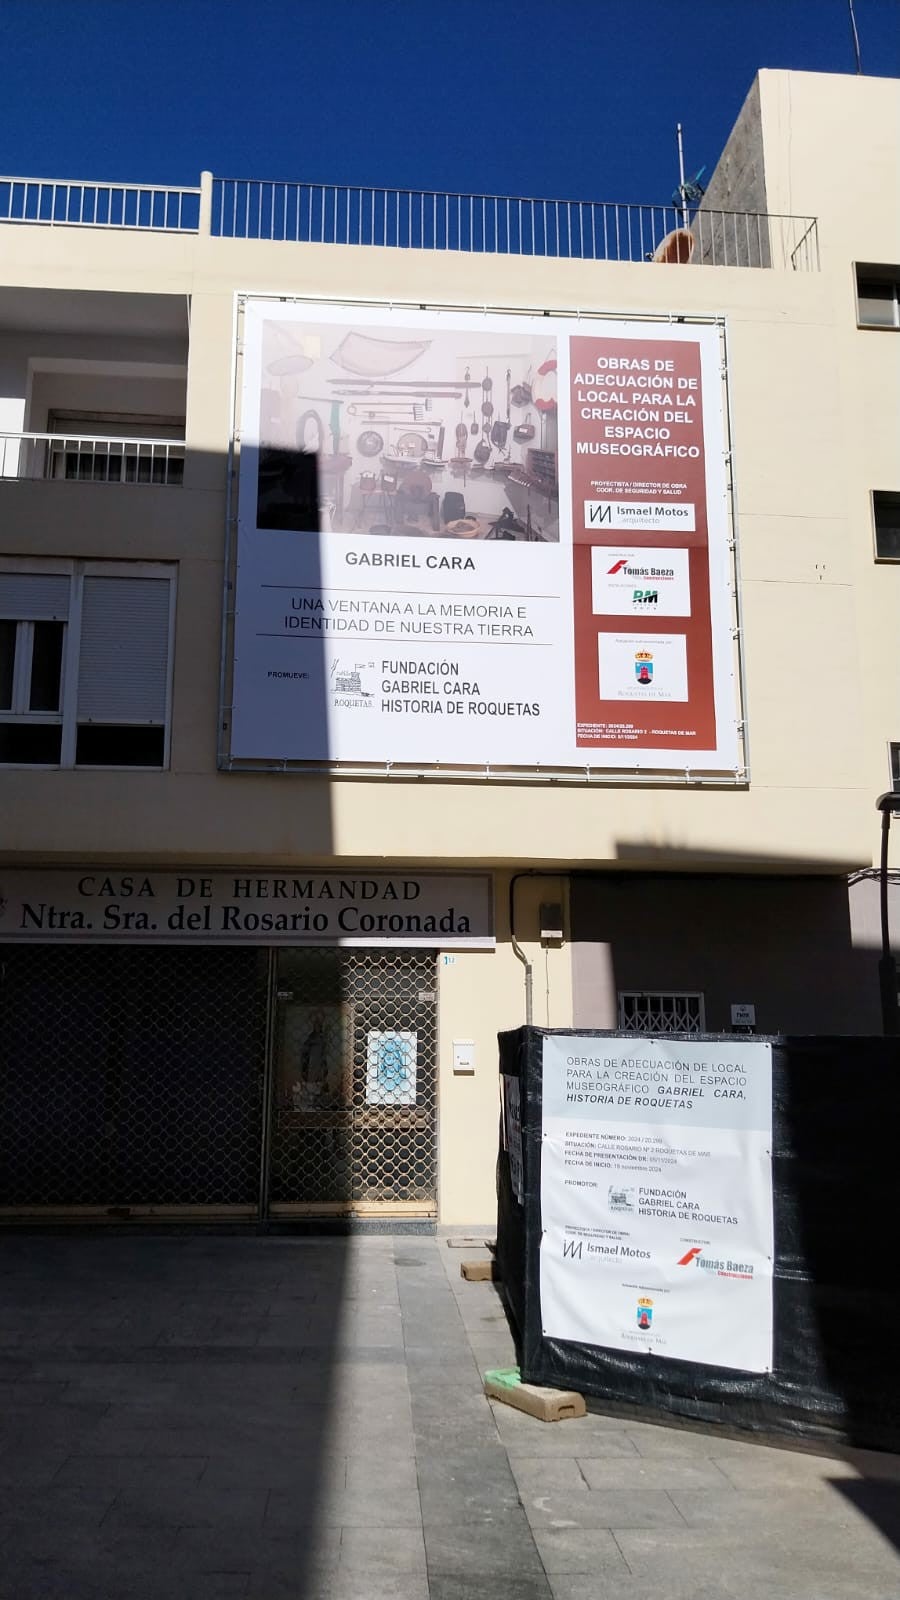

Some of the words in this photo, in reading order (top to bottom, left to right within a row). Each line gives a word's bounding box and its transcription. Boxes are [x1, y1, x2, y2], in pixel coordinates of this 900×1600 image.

[597, 357, 650, 371] OBRAS
[655, 360, 674, 372] DE
[574, 373, 673, 389] ADECUACIÓN
[678, 378, 698, 390] DE
[578, 390, 628, 404] LOCAL
[632, 393, 672, 406] PARA
[676, 395, 696, 406] LA
[581, 408, 659, 422] CREACIÓN
[664, 411, 693, 423] DEL
[605, 426, 670, 440] ESPACIO
[576, 442, 700, 458] MUSEOGRÁFICO
[617, 506, 652, 516] Ismael
[655, 506, 689, 517] Motos
[345, 552, 421, 569] GABRIEL
[426, 556, 476, 570] CARA
[651, 567, 674, 577] Baeza
[291, 598, 324, 611] UNA
[328, 599, 401, 614] VENTANA
[403, 602, 414, 615] A
[418, 603, 436, 616] LA
[440, 604, 514, 619] MEMORIA
[517, 606, 527, 619] E
[284, 616, 370, 632] IDENTIDAD
[374, 620, 395, 633] DE
[400, 621, 473, 636] NUESTRA
[478, 624, 534, 638] TIERRA
[382, 659, 459, 676] FUNDACIÓN
[382, 680, 440, 695] GABRIEL
[444, 682, 481, 696] CARA
[382, 700, 444, 714] HISTORIA
[447, 702, 464, 715] DE
[468, 702, 540, 717] ROQUETAS
[78, 876, 155, 898] CASA
[176, 878, 214, 898] DE
[232, 879, 421, 900] HERMANDAD
[20, 903, 93, 930] Ntra.
[103, 904, 158, 930] Sra.
[168, 905, 211, 930] del
[221, 906, 328, 932] Rosario
[338, 907, 472, 933] Coronada
[566, 1056, 600, 1067] OBRAS
[604, 1059, 618, 1068] DE
[621, 1059, 690, 1072] ADECUACIÓN
[694, 1062, 708, 1072] DE
[712, 1064, 747, 1074] LOCAL
[566, 1069, 592, 1080] PARA
[597, 1071, 610, 1080] LA
[614, 1071, 668, 1083] CREACIÓN
[675, 1075, 695, 1084] DEL
[700, 1076, 747, 1086] ESPACIO
[566, 1082, 649, 1094] MUSEOGRÁFICO
[657, 1086, 705, 1097] GABRIEL
[714, 1089, 746, 1100] CARA,
[566, 1094, 614, 1105] HISTORIA
[617, 1096, 631, 1106] DE
[634, 1097, 693, 1109] ROQUETAS
[566, 1132, 600, 1140] EXPEDIENTE
[565, 1150, 584, 1158] FECHA
[594, 1152, 638, 1161] PRESENTACIÓN
[639, 1187, 687, 1199] FUNDACIÓN
[639, 1198, 674, 1208] GABRIEL
[677, 1200, 700, 1210] CARA
[639, 1208, 676, 1219] HISTORIA
[679, 1211, 689, 1220] DE
[692, 1213, 738, 1225] ROQUETAS
[587, 1242, 619, 1256] Ismael
[620, 1245, 651, 1260] Motos
[727, 1260, 754, 1274] Baeza
